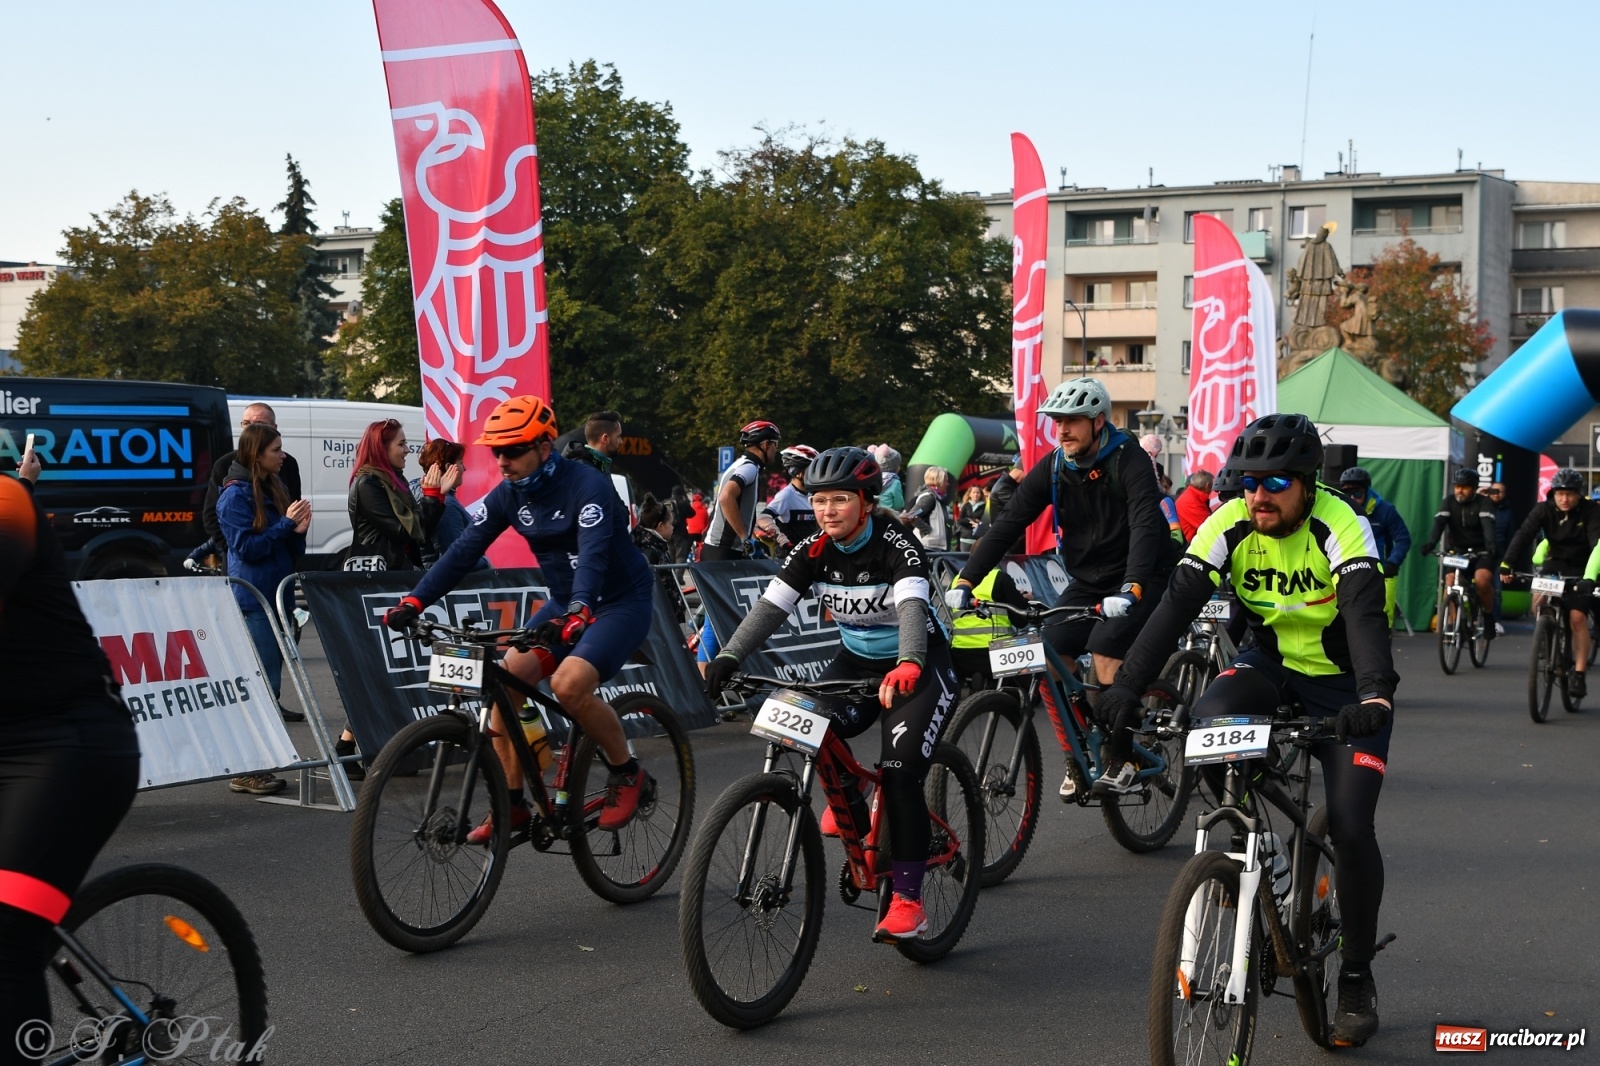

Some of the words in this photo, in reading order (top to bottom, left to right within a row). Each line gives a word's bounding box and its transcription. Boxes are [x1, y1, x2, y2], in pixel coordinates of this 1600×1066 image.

[722, 449, 731, 470] P
[142, 512, 194, 522] MAXXIS
[1341, 561, 1372, 574] STRAVA
[822, 591, 880, 615] etixx
[1200, 604, 1225, 615] 239
[999, 649, 1035, 666] 3090
[440, 663, 473, 681] 1343
[162, 676, 250, 717] FRIENDS
[768, 707, 814, 735] 3228
[1202, 730, 1256, 748] 3184
